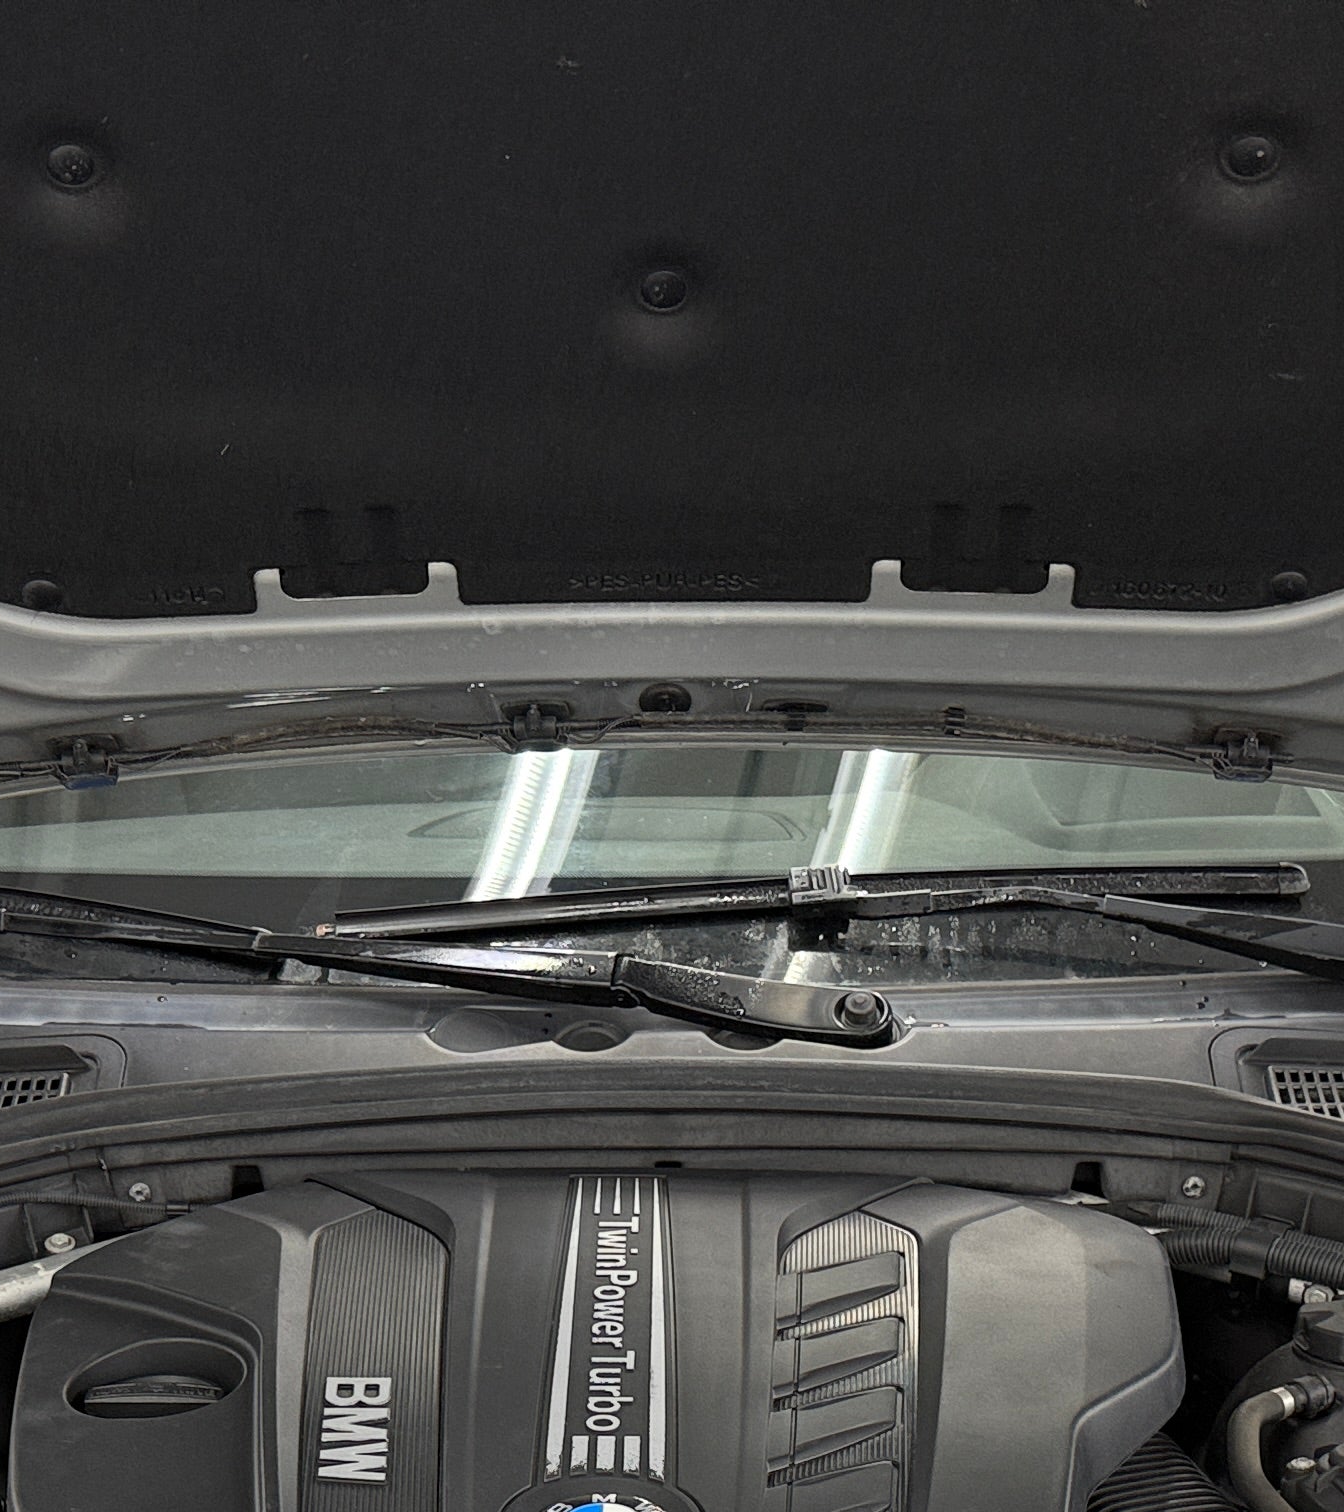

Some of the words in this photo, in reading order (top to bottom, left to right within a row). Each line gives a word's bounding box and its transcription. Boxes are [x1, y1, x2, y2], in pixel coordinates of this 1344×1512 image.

[591, 1216, 639, 1348] TwinPower
[317, 1376, 392, 1482] BMW
[586, 1350, 636, 1432] Turbo
